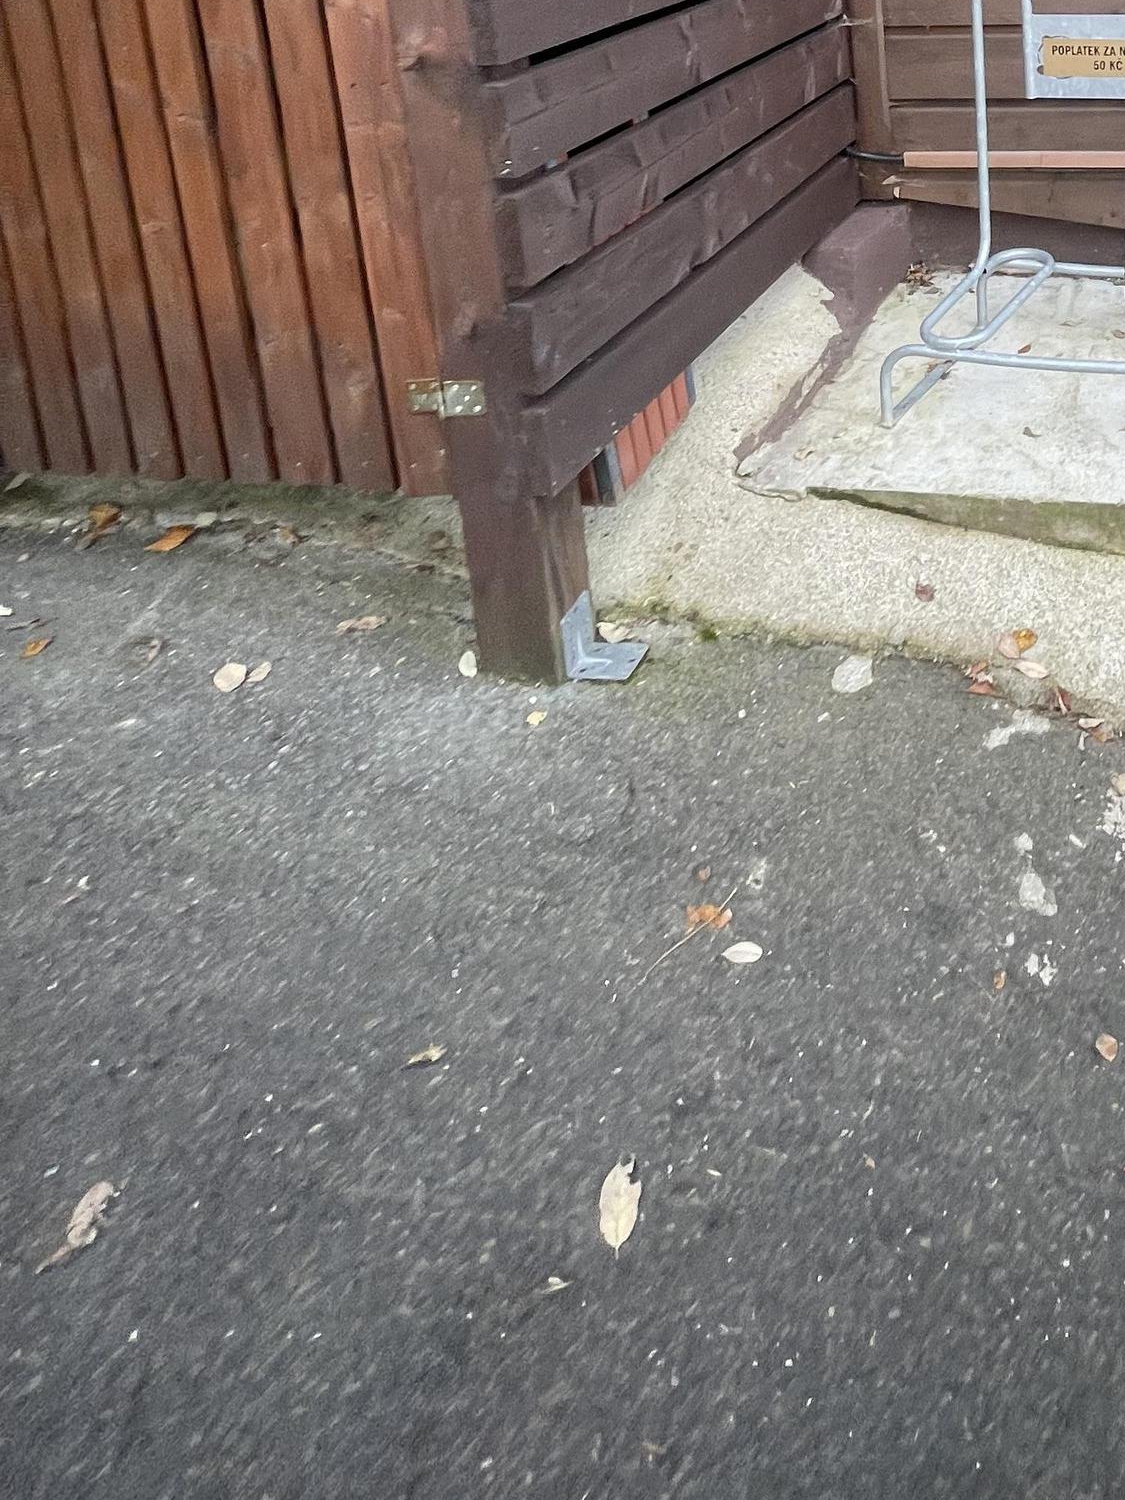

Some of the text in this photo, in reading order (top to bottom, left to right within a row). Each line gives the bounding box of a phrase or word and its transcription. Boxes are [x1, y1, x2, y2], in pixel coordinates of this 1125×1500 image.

[1051, 45, 1101, 56] POPLATEK
[1103, 46, 1116, 57] ZA
[1093, 60, 1106, 71] 50
